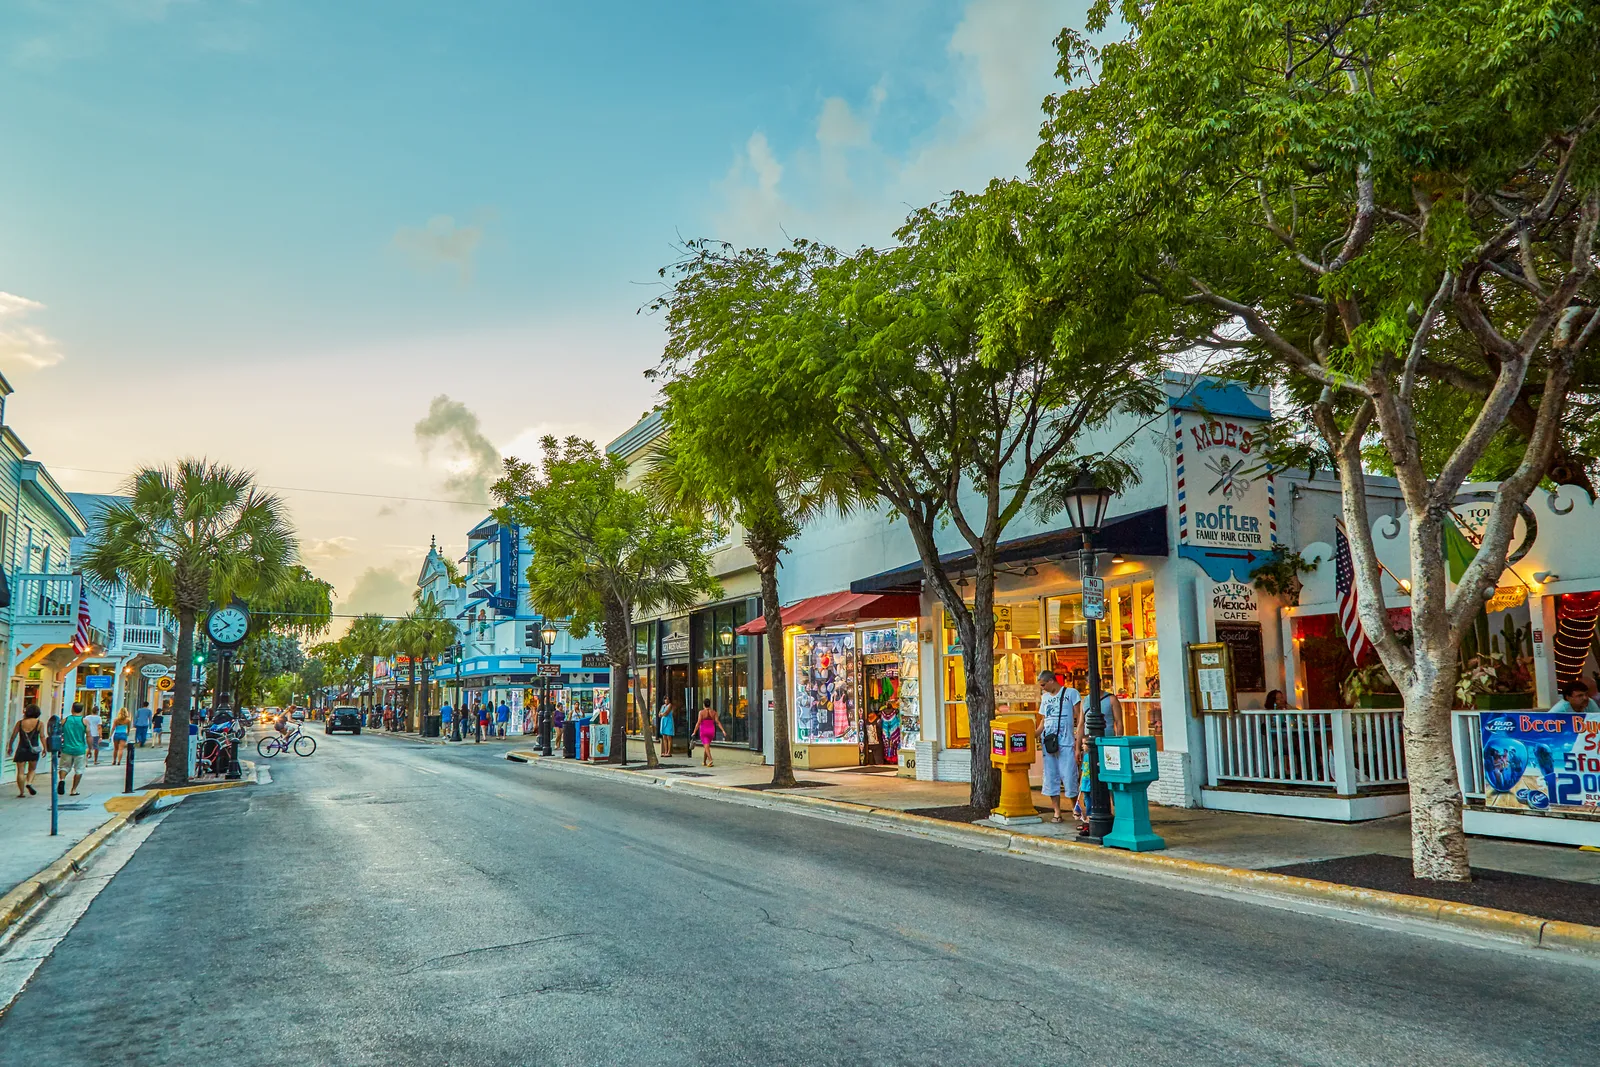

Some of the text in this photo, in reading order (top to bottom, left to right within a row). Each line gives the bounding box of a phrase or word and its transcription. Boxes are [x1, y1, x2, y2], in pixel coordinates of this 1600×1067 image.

[1190, 421, 1252, 454] MOE'S
[1196, 529, 1218, 541] FAMILY
[1220, 531, 1236, 542] HAIR
[1237, 532, 1262, 544] CENTER
[1089, 579, 1098, 588] NO
[1212, 584, 1229, 595] OLD
[1213, 595, 1257, 611] MEXICAN
[1223, 611, 1247, 620] CAFE
[1519, 714, 1566, 732] Beer
